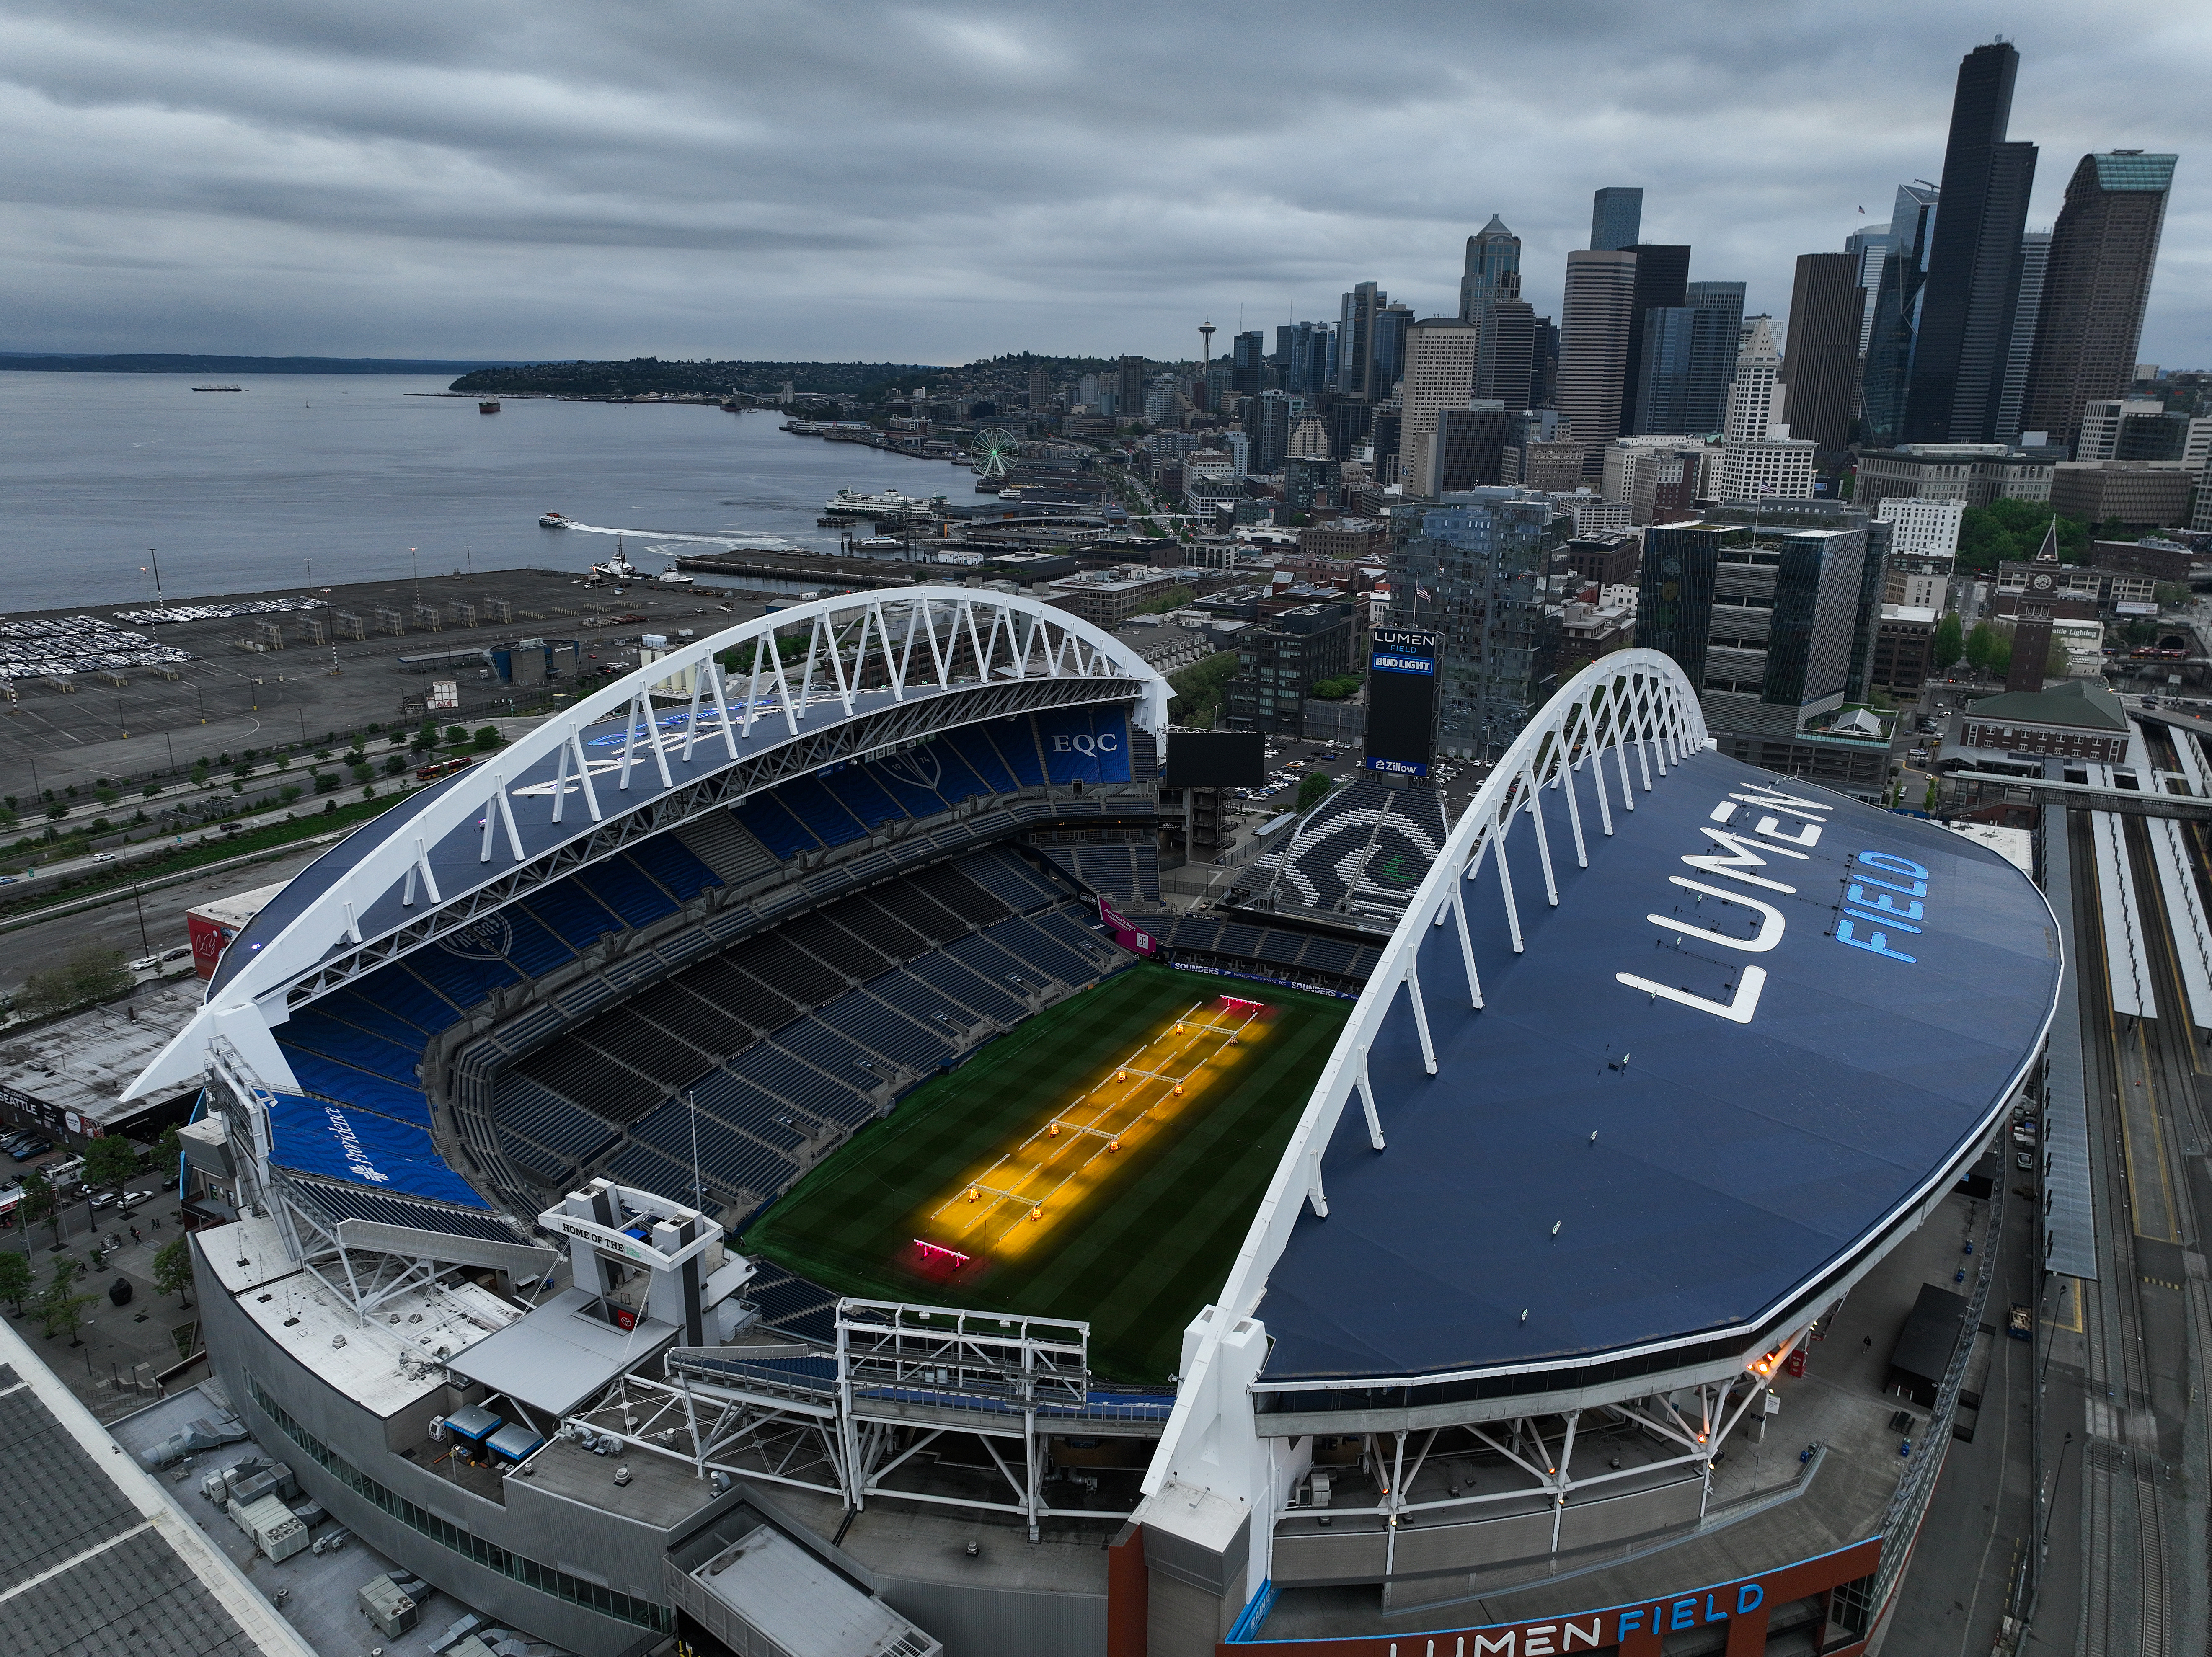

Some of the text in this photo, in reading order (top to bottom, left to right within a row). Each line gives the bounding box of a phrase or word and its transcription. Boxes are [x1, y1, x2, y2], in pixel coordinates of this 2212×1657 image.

[1375, 632, 1434, 646] LUMEN
[2069, 629, 2096, 638] Lighting
[1376, 657, 1430, 671] BUD LIGHT
[1051, 733, 1117, 757] EQC
[1385, 761, 1416, 774] Zillow
[1615, 782, 1833, 1024] LUMEN
[1836, 851, 1929, 963] FIELD
[1104, 908, 1126, 924] America's
[1126, 922, 1137, 931] Best
[1108, 914, 1119, 924] Mobile
[1118, 921, 1131, 932] Network
[1174, 963, 1219, 975] SOUNDERS
[1291, 982, 1336, 997] SOUNDERS
[735, 1049, 744, 1058] DELTA
[3, 1088, 23, 1098] WELCOME
[0, 1091, 38, 1115] SEATTLE
[640, 1111, 650, 1121] DELTA
[326, 1107, 373, 1166] Providence
[563, 1223, 589, 1240] HOME
[592, 1234, 602, 1244] OF
[605, 1238, 624, 1252] THE
[1251, 1589, 1274, 1629] RAINIER
[1618, 1584, 1764, 1642] FIELD
